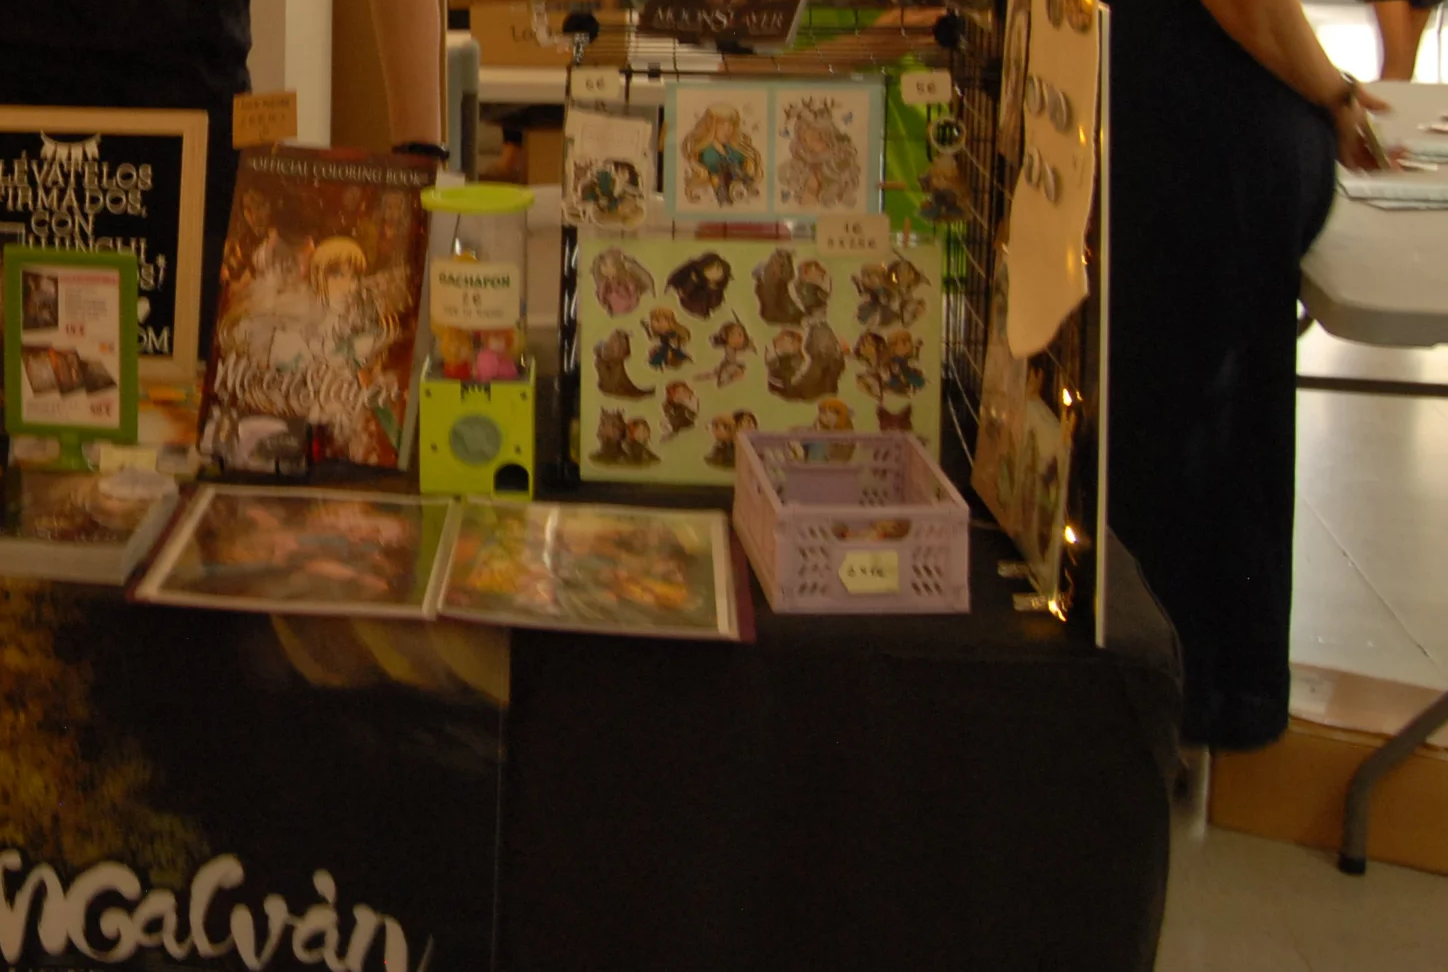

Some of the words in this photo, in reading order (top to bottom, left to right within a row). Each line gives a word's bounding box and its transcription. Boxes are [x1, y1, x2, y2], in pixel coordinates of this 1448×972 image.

[252, 158, 309, 178] OFFICIAL
[312, 163, 382, 183] COLORING
[30, 209, 95, 237] CON
